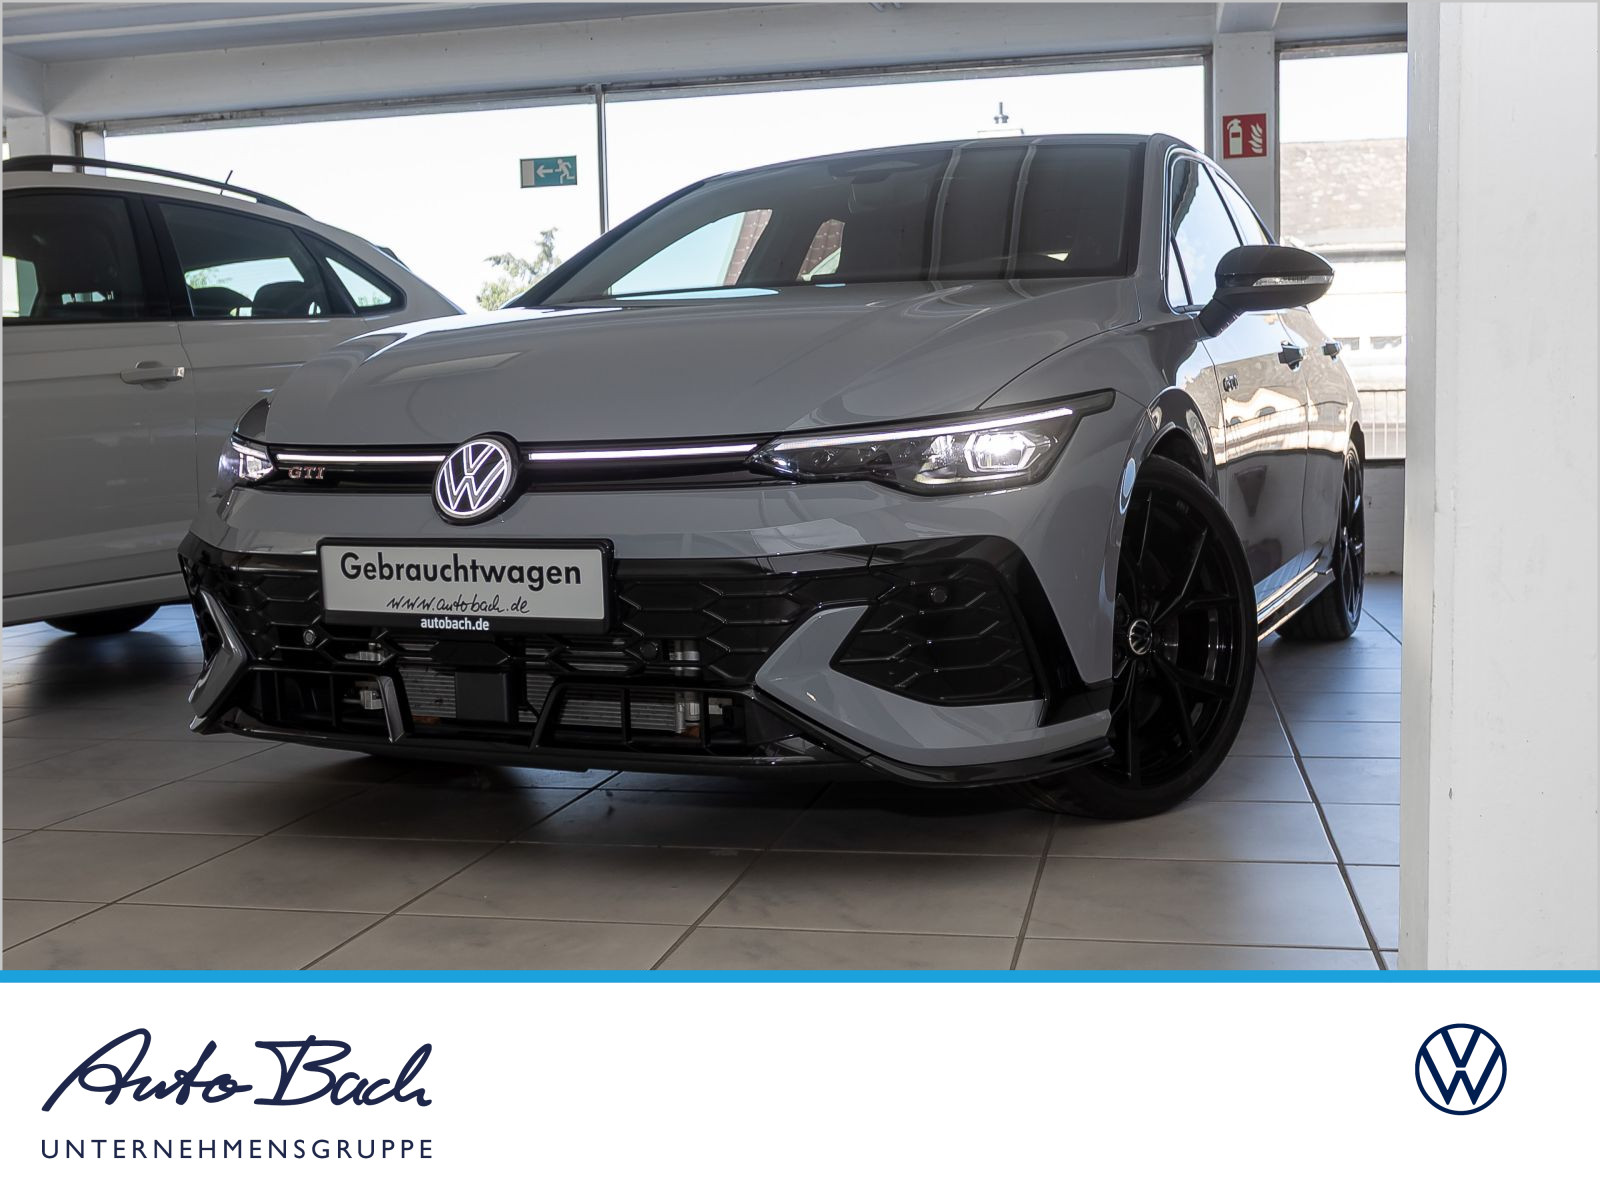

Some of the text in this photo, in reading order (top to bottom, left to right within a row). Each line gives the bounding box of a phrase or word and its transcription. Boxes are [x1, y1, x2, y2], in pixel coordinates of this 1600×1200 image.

[288, 466, 324, 479] GTI
[340, 551, 582, 592] Gebrauchtwagen
[386, 593, 531, 614] www.autobach.de
[420, 616, 490, 631] autobach.de
